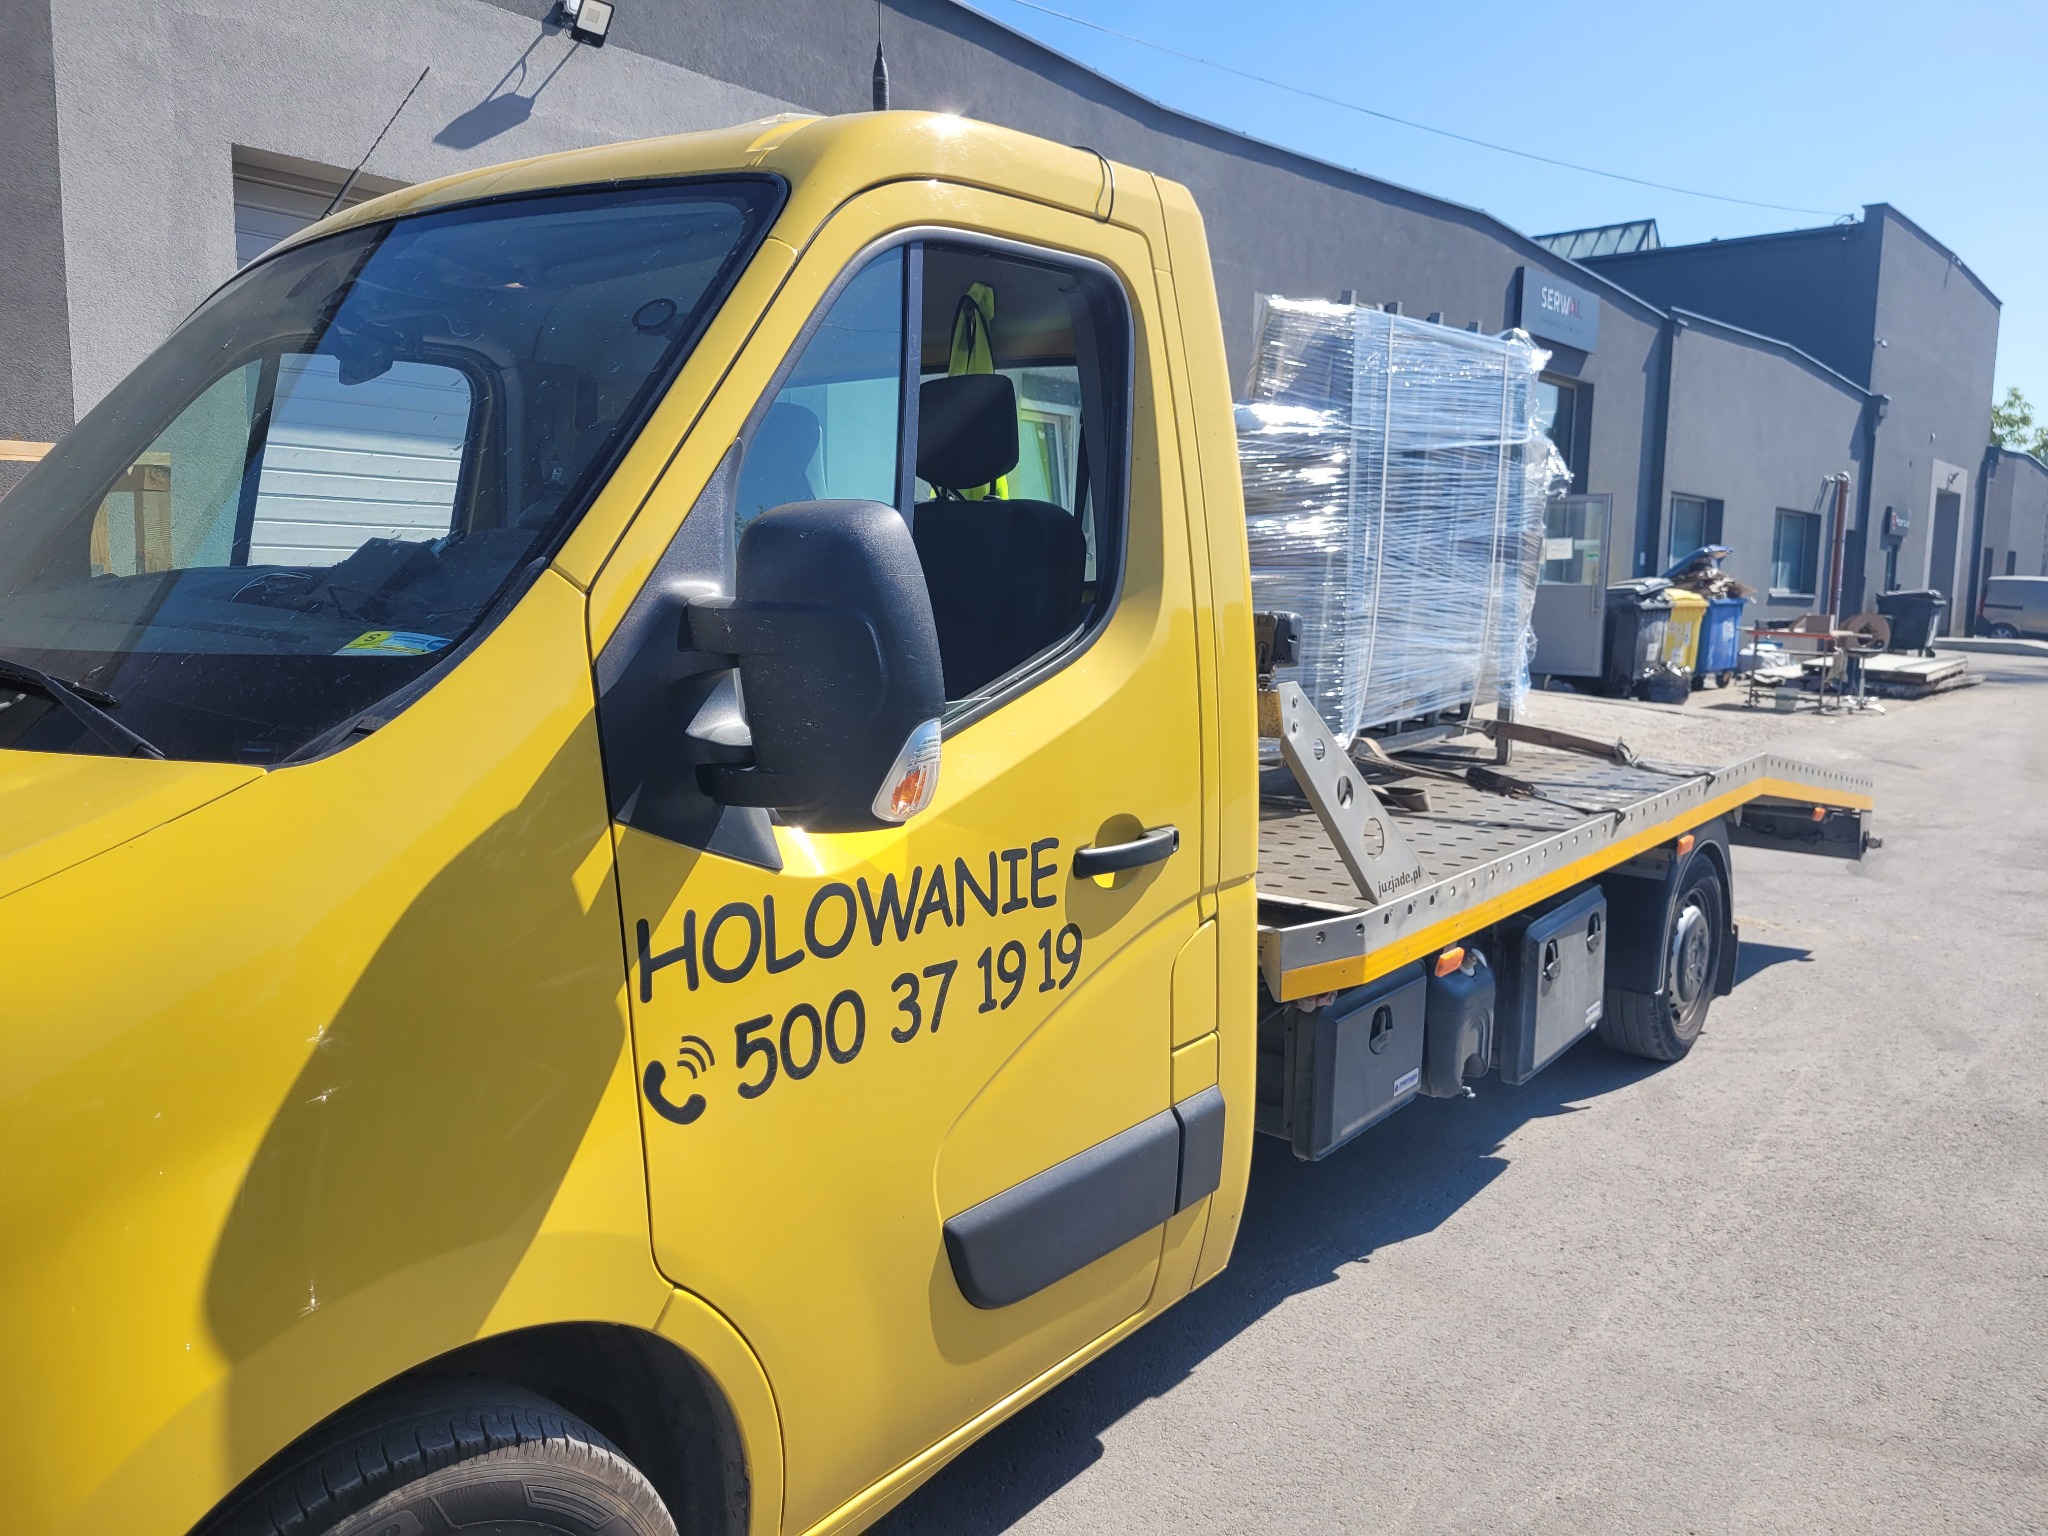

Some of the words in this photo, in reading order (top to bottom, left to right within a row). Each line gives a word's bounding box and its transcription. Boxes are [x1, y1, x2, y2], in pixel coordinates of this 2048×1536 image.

[636, 837, 1060, 1003] HOLOWANIE
[1377, 864, 1421, 899] juzjade.pl
[735, 988, 866, 1100] 500
[890, 959, 959, 1044] 37
